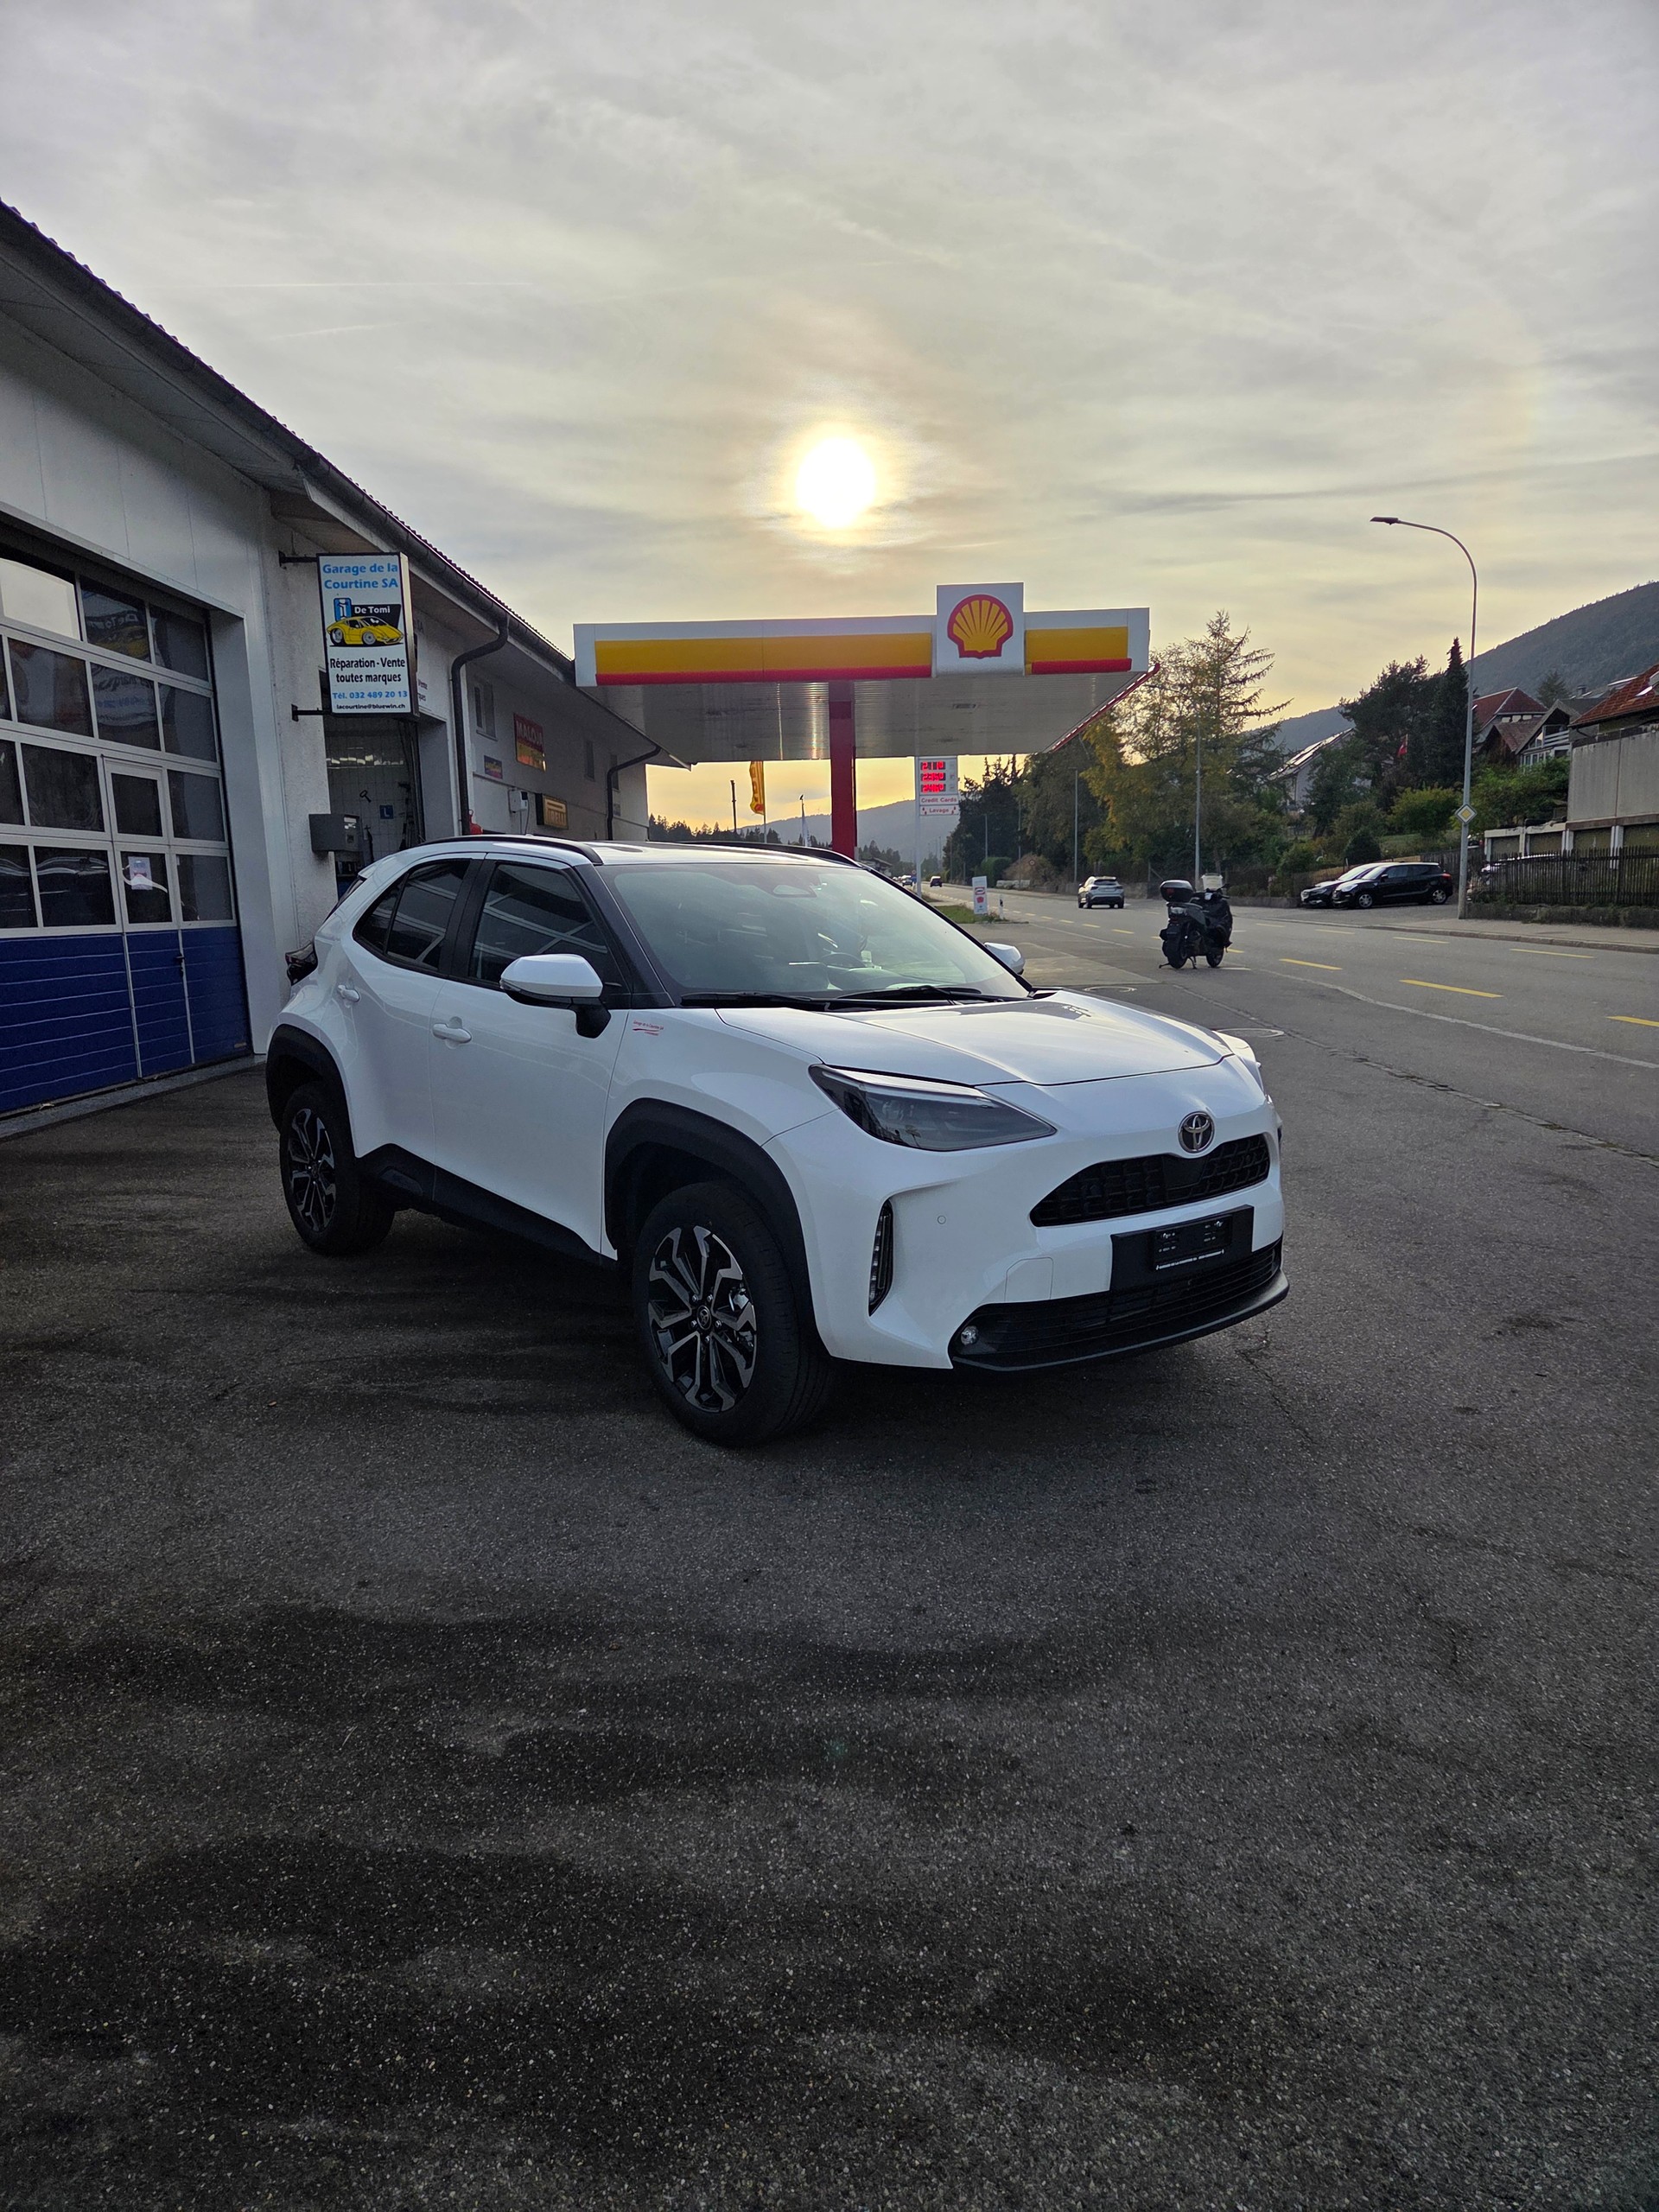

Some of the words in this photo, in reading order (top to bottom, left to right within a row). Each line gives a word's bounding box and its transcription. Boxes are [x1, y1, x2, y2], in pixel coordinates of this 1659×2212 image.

[322, 564, 366, 575] Garage
[369, 563, 385, 573] de
[387, 563, 398, 572] la
[324, 579, 378, 589] Courtine
[381, 578, 398, 588] SA
[330, 658, 375, 671] Réparation
[380, 658, 405, 667] Vente
[336, 673, 363, 683] toutes
[365, 674, 401, 685] marques
